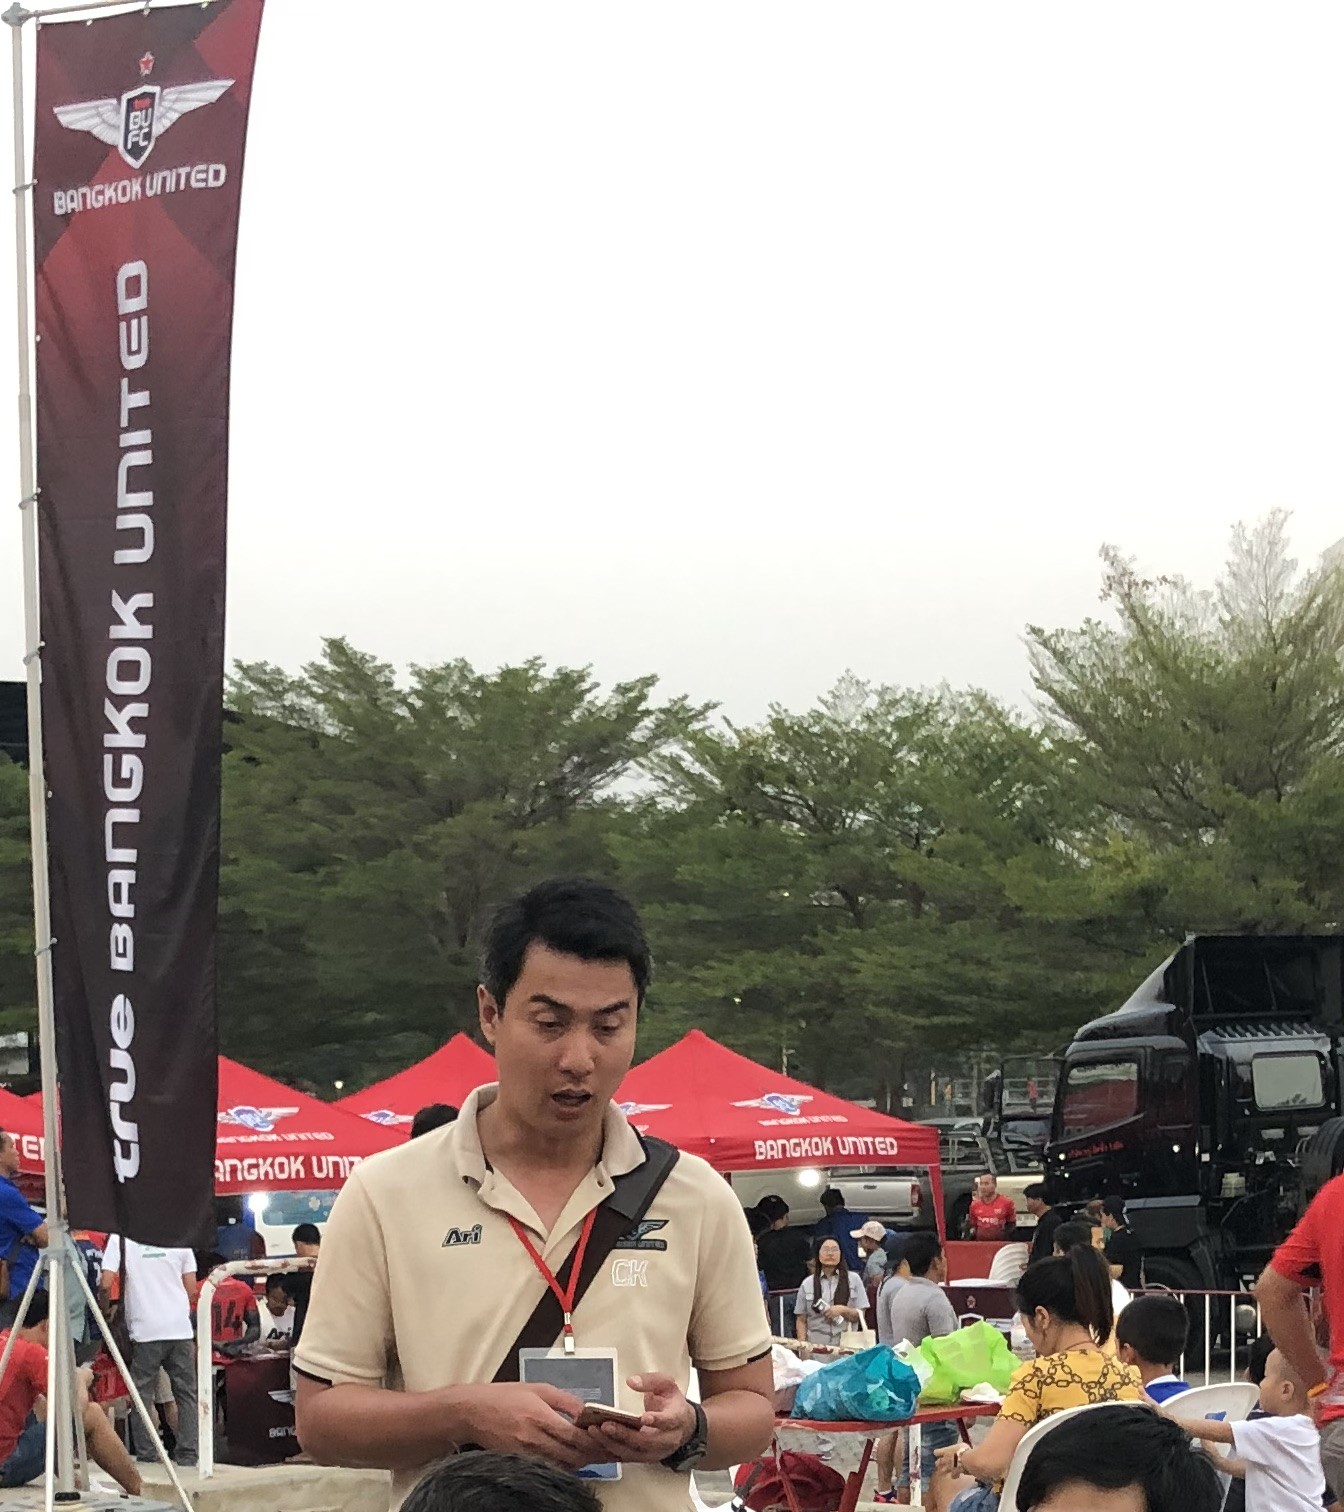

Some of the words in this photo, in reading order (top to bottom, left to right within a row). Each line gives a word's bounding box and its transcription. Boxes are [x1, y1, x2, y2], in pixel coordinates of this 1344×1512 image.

[128, 109, 152, 131] BU
[127, 127, 150, 149] FC
[53, 175, 142, 216] BANGKOK
[144, 163, 227, 197] UNITED
[114, 259, 155, 566] UNITED
[102, 588, 155, 971] BANGKOK
[103, 993, 141, 1184] true
[754, 1136, 834, 1160] BANGKOK
[836, 1136, 898, 1155] UNITED
[215, 1155, 306, 1182] ANGKOK
[442, 1223, 484, 1247] Ari
[612, 1259, 648, 1287] CK
